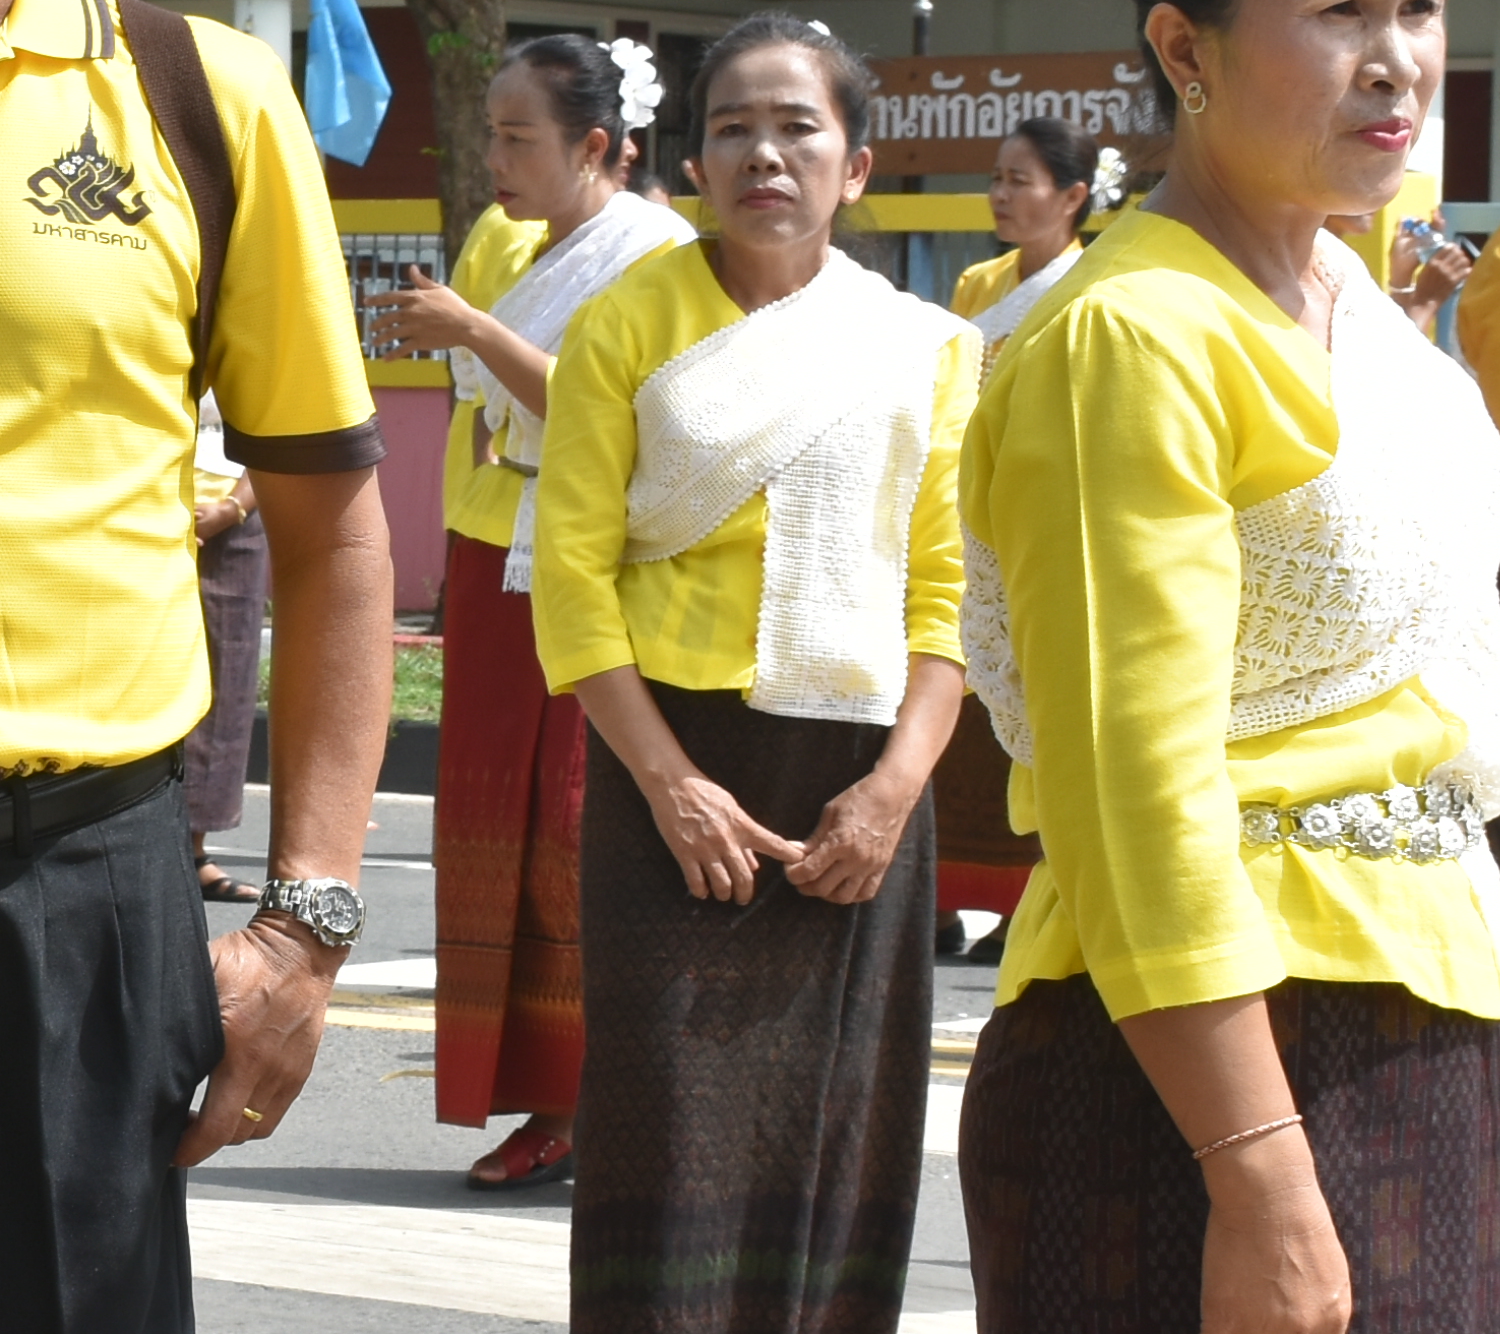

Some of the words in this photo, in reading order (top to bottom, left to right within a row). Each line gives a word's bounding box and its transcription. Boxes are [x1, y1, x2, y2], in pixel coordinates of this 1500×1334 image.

[868, 62, 1156, 141] านพักอัยการจัง
[33, 222, 147, 250] มหาสารคาม
